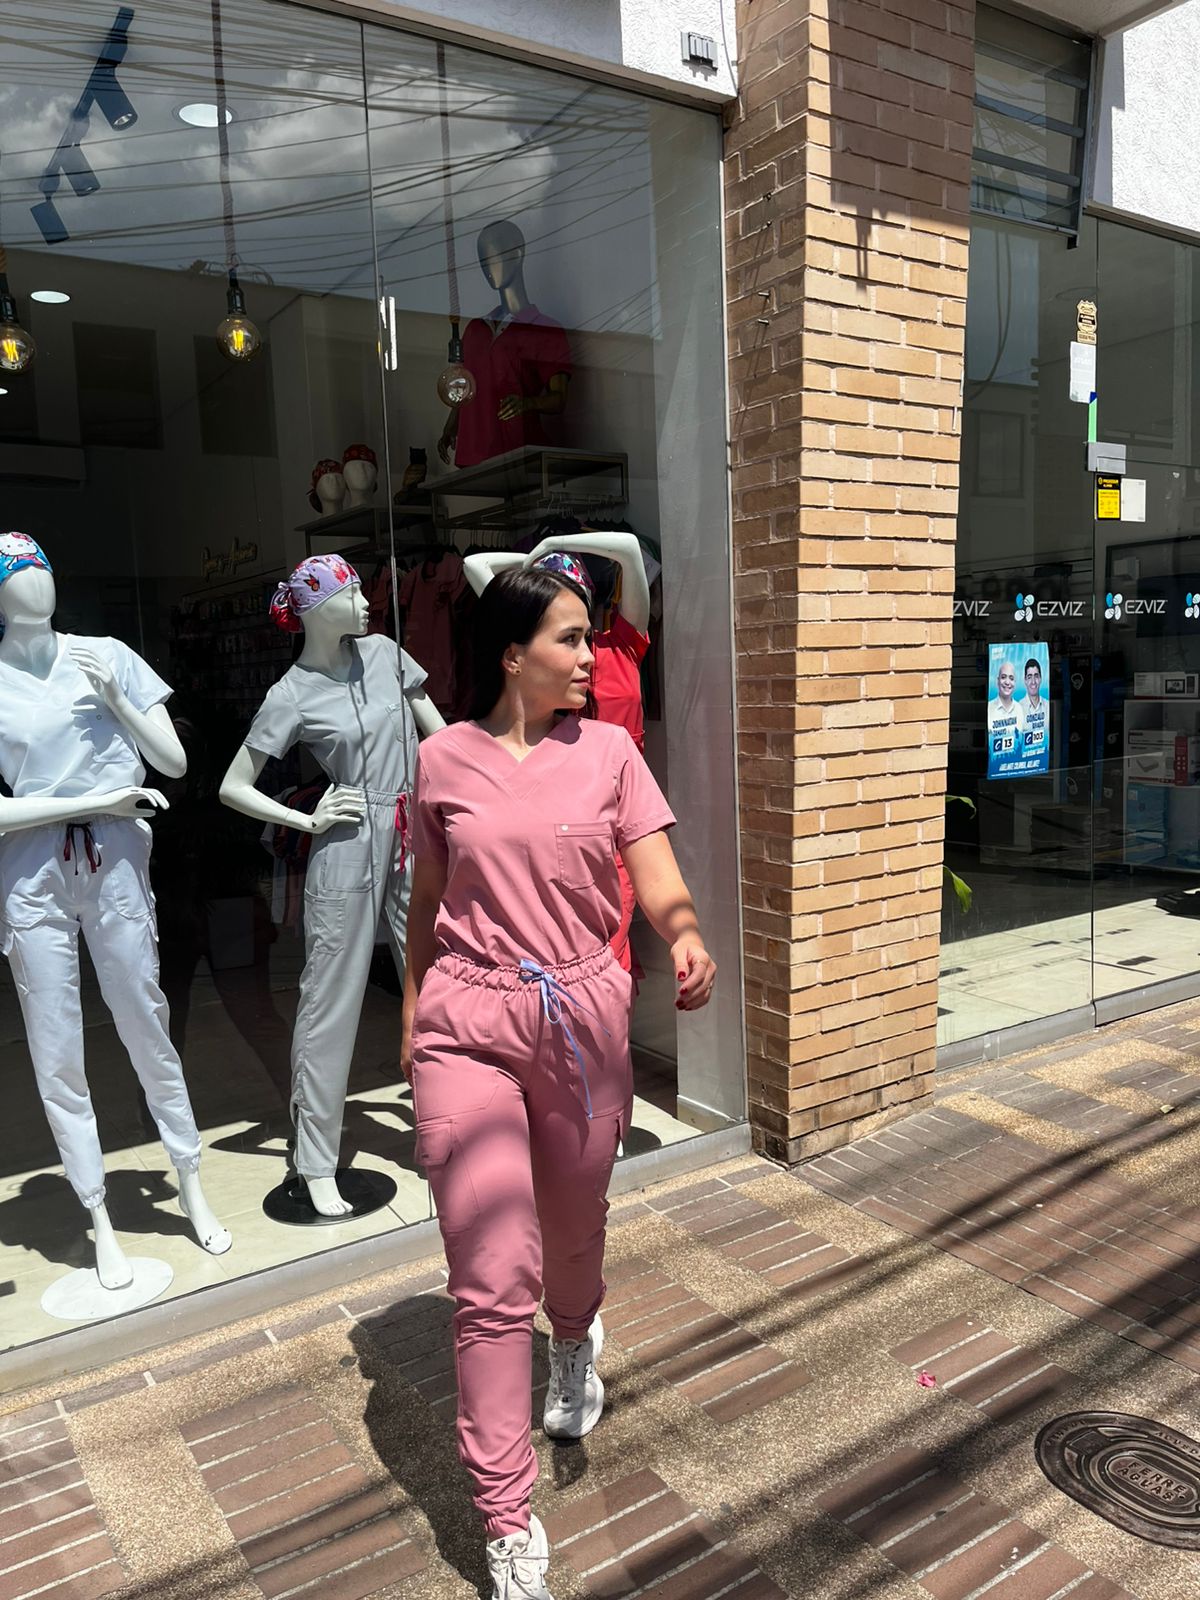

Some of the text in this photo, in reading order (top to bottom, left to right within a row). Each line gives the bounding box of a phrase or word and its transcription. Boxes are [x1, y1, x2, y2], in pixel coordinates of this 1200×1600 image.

[953, 601, 989, 616] ZVIZ
[1037, 601, 1084, 616] EZVIZ
[1125, 600, 1167, 614] EZVIZ
[1004, 738, 1013, 748] 13
[1033, 731, 1043, 741] 103
[1117, 1467, 1175, 1501] AGUAS
[1128, 1461, 1187, 1494] FERRE
